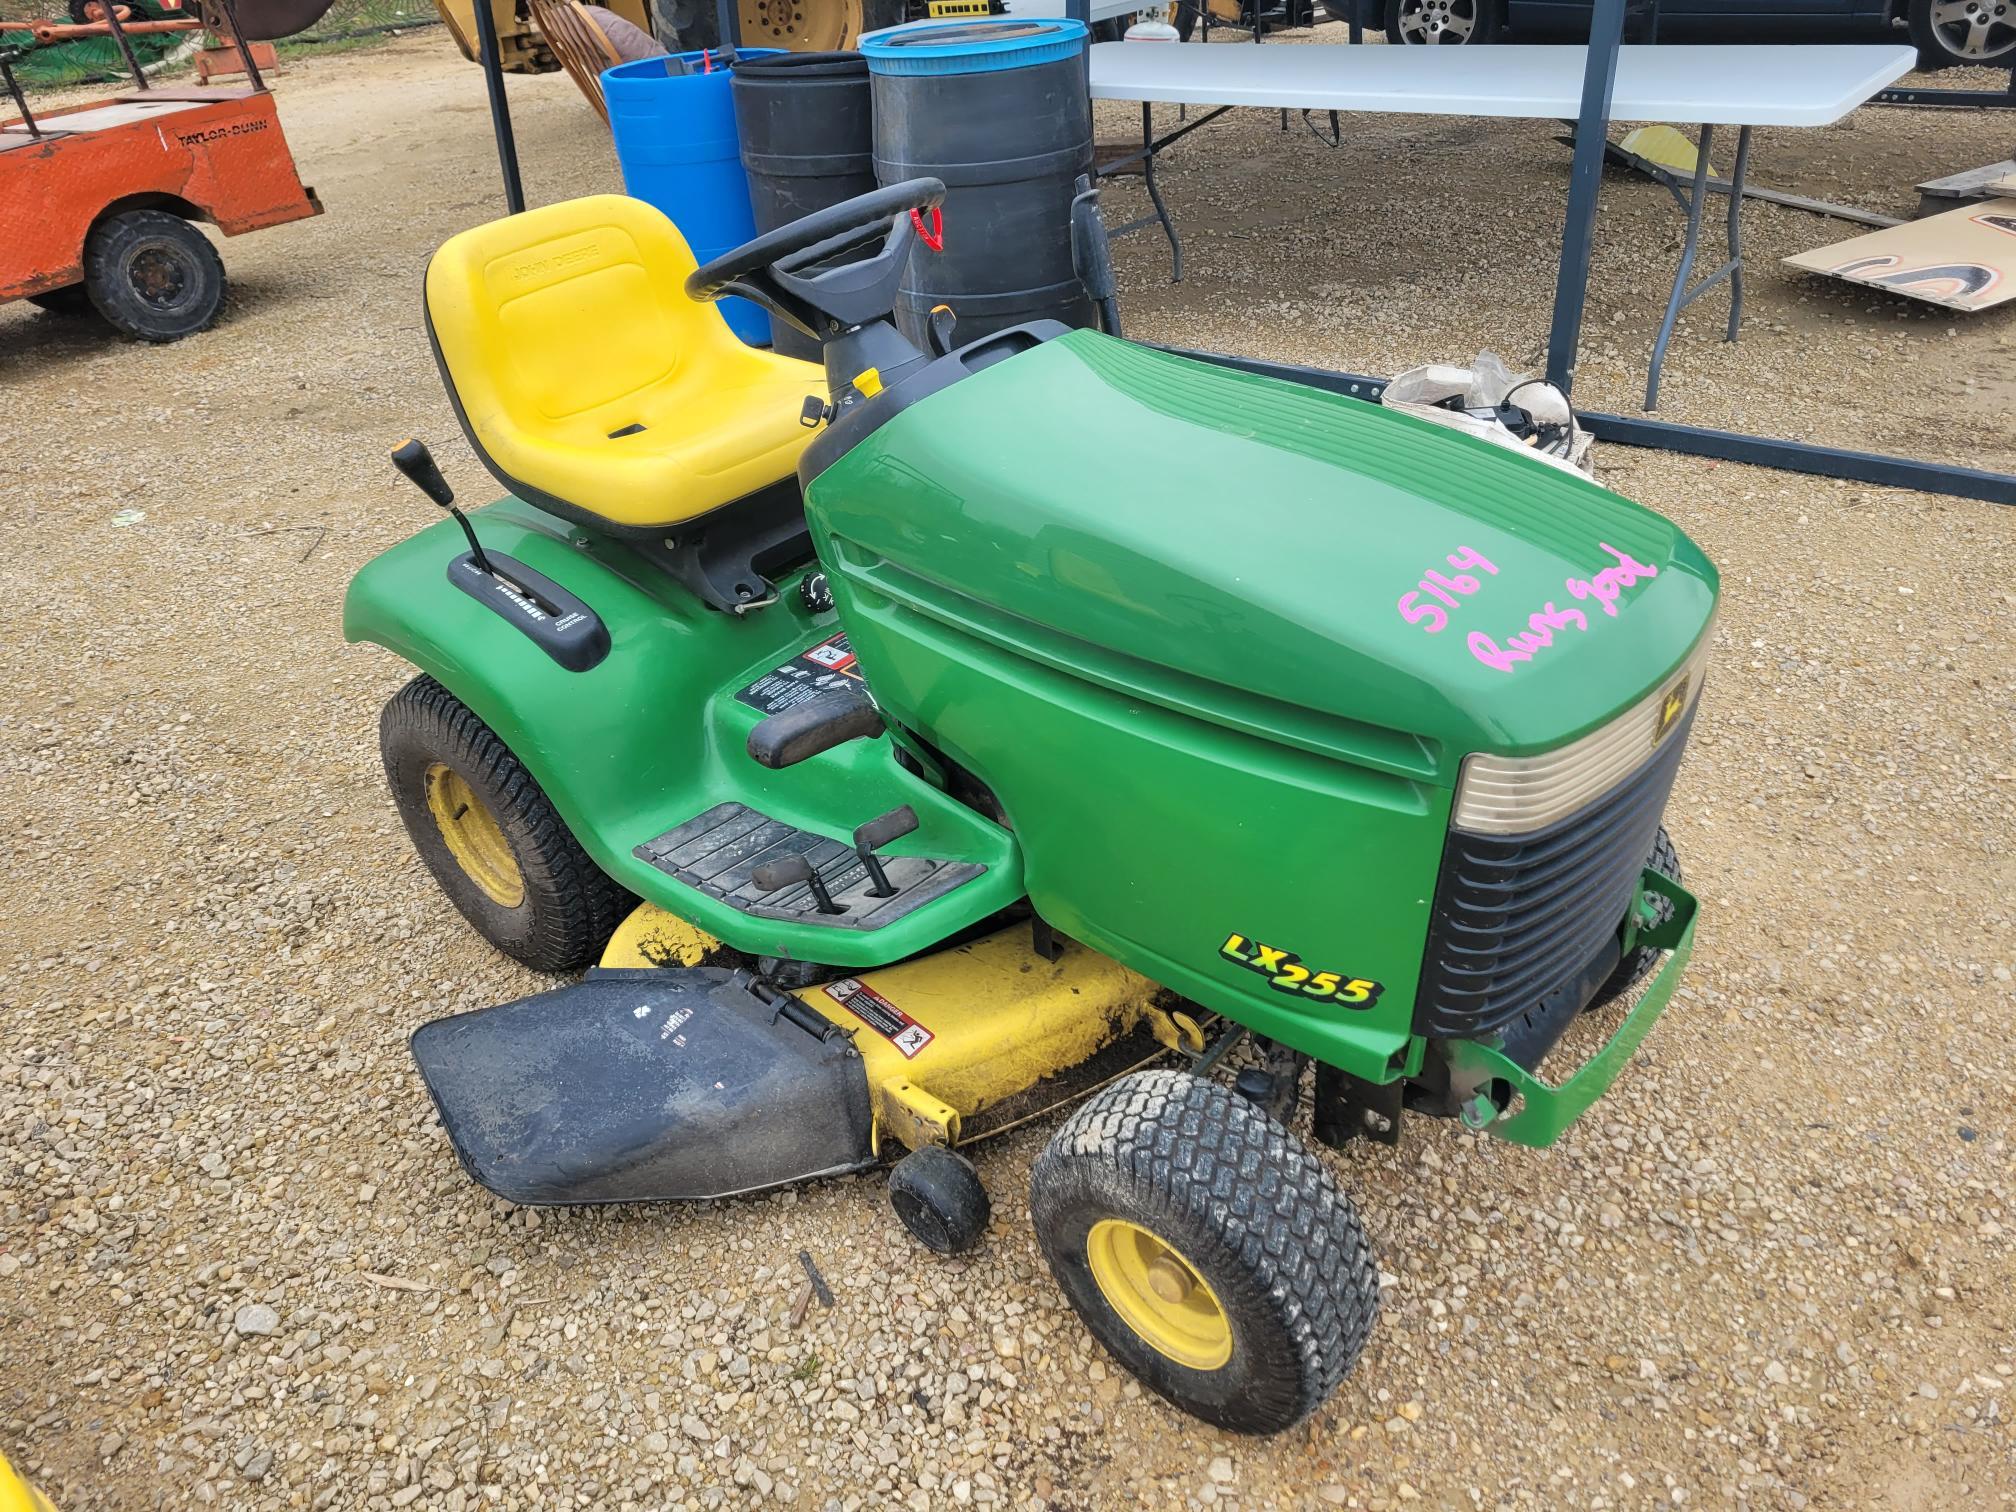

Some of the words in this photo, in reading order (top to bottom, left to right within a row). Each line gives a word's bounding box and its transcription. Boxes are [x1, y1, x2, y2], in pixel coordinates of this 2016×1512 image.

[178, 119, 268, 147] TAYLOR-DUNN
[551, 242, 600, 269] DEERE
[1397, 545, 1499, 633] 5164
[554, 611, 580, 627] CRUISE
[556, 614, 588, 632] CONTROL
[1466, 601, 1588, 673] Runs
[879, 998, 904, 1017] DANGER
